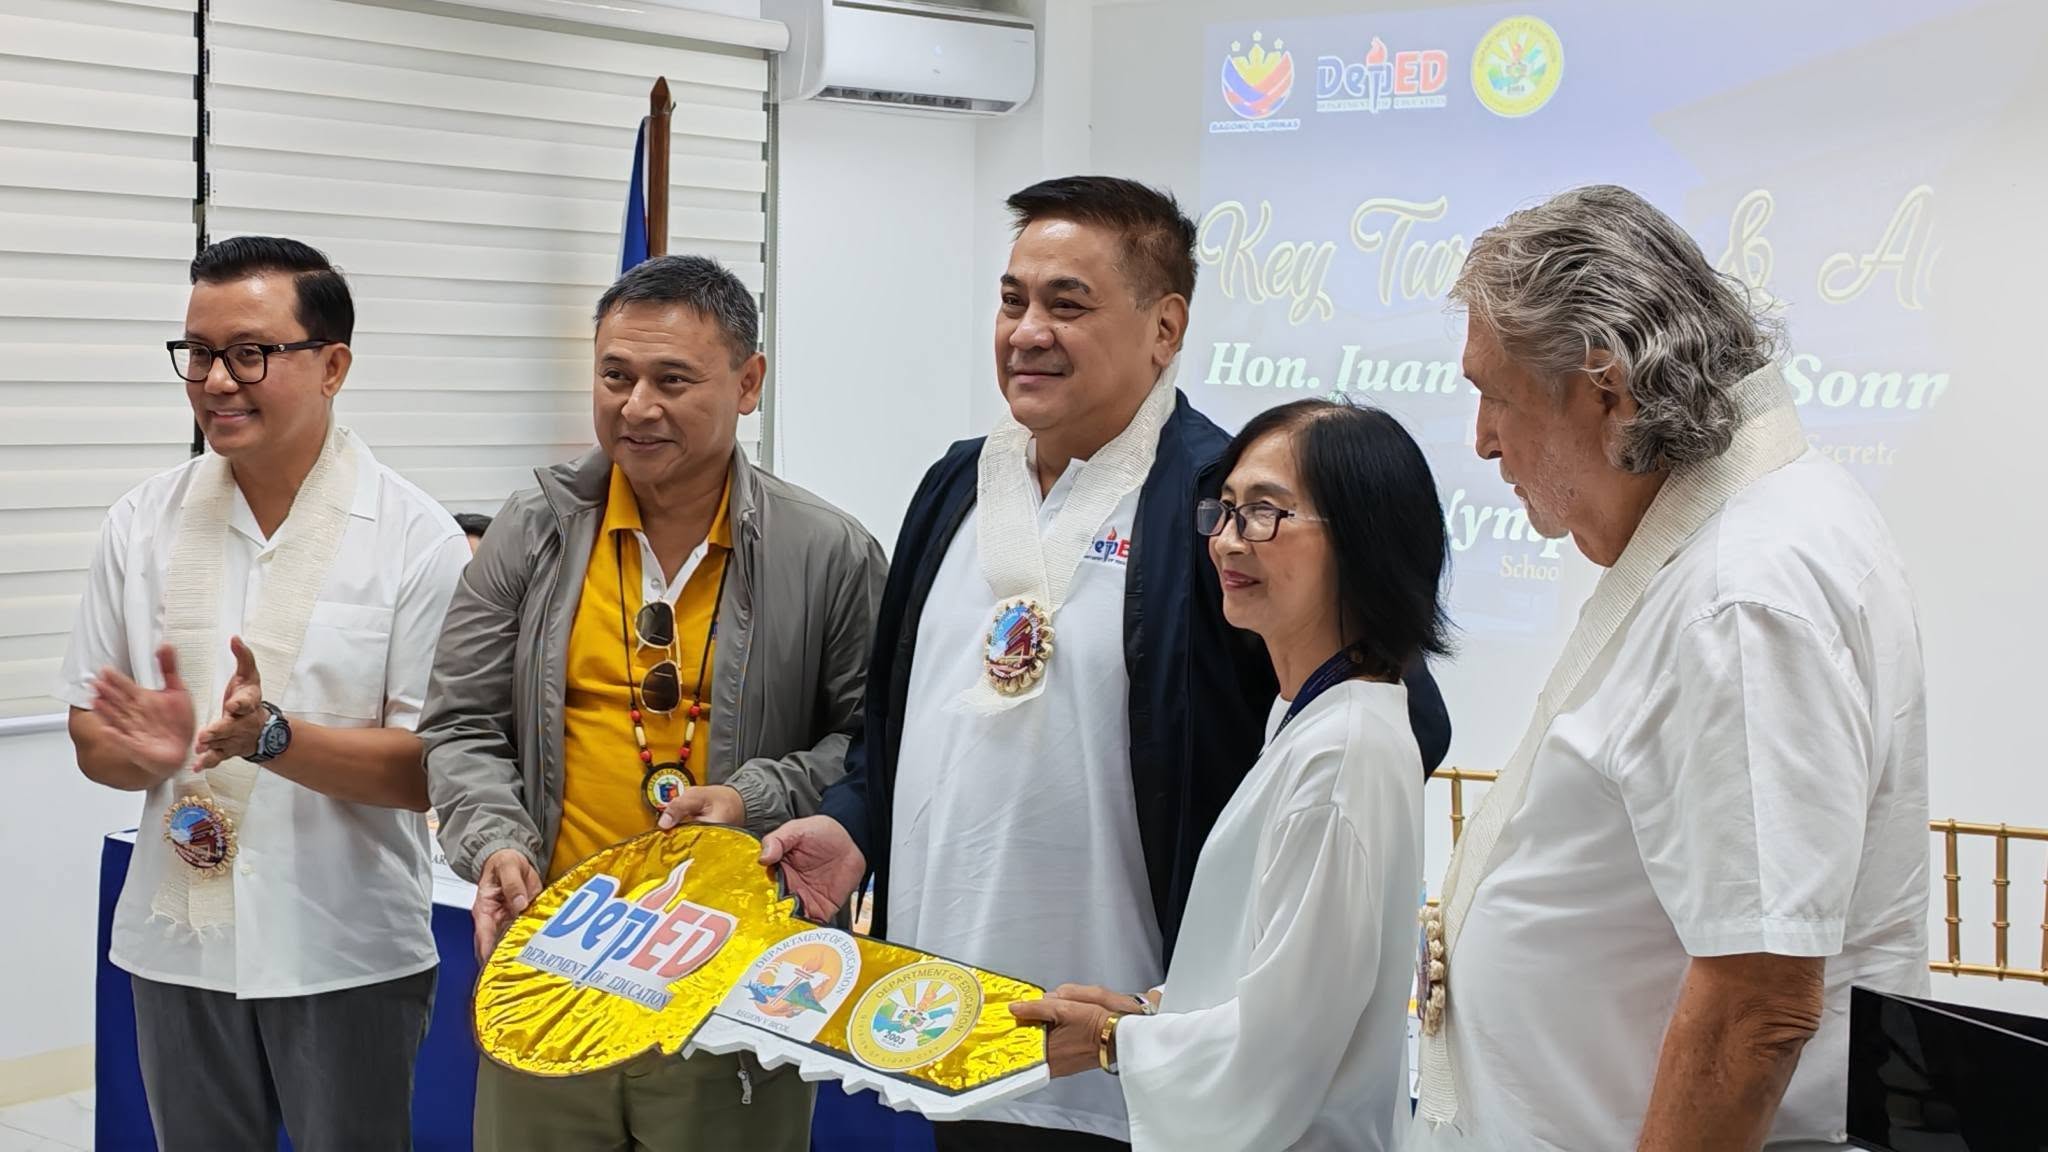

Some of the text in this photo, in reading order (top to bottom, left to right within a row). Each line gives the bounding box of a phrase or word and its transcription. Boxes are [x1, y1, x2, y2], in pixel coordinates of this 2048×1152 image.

[1316, 50, 1448, 99] DepED
[1199, 200, 1338, 326] Key
[1204, 342, 1320, 390] Hon.
[1328, 345, 1459, 402] Juan
[543, 876, 733, 980] DepED
[521, 945, 673, 1006] DEPARTMENT OF EDUCATION
[755, 932, 857, 995] DEPARTMENT OF EDUCATION
[876, 968, 975, 1032] DEPARTMENT OF EDUCATION
[884, 1031, 906, 1045] 2003
